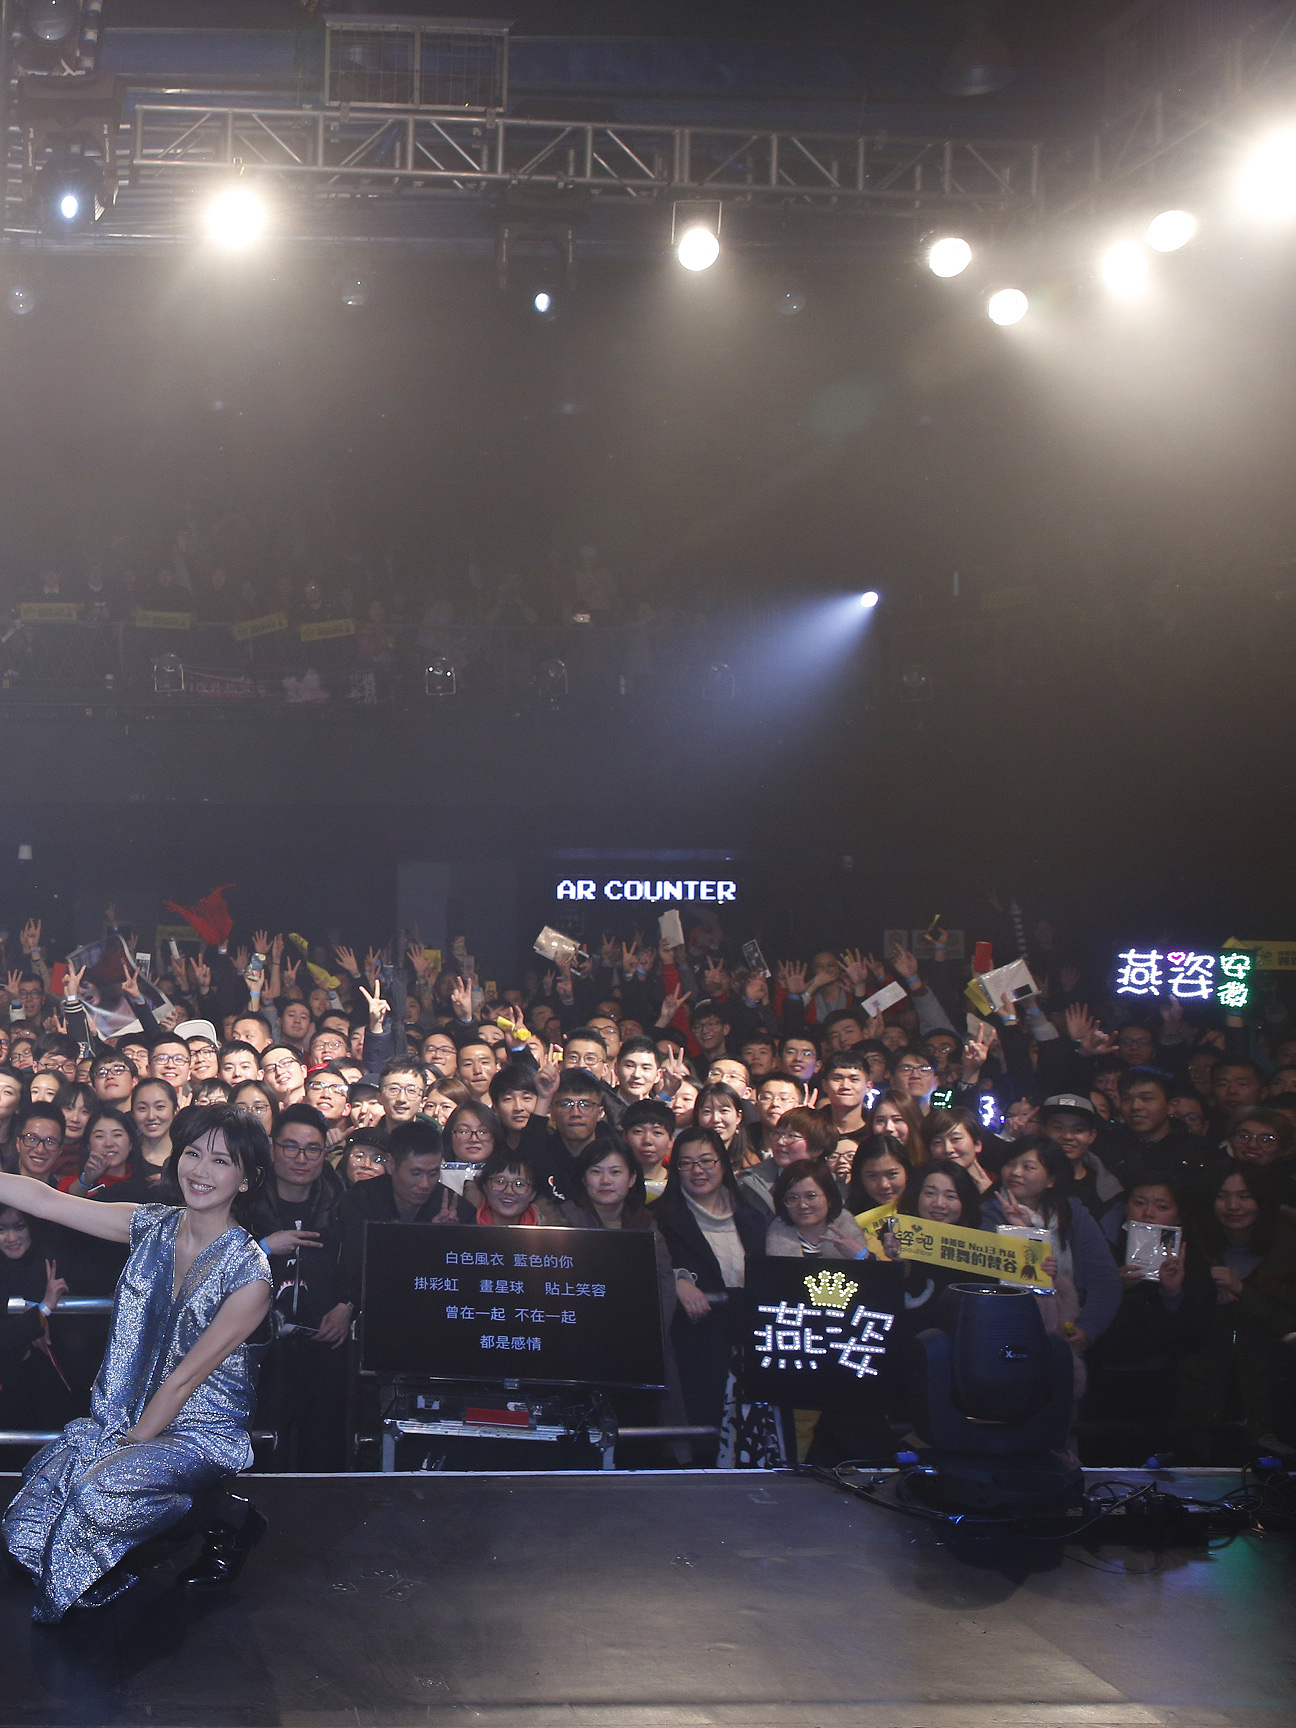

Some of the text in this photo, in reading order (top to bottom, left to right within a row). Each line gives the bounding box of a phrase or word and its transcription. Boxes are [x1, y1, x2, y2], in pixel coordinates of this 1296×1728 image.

[556, 879, 738, 901] AR COUNTER
[1116, 948, 1216, 1000] 燕姿
[445, 1250, 574, 1269] 白色風衣 藍色的你
[414, 1276, 607, 1298] 掛彩虹 畫星球 貼上笑容
[445, 1305, 577, 1325] 曾在一起 不在一起
[479, 1334, 542, 1351] 都是感情
[753, 1300, 895, 1379] 燕姿
